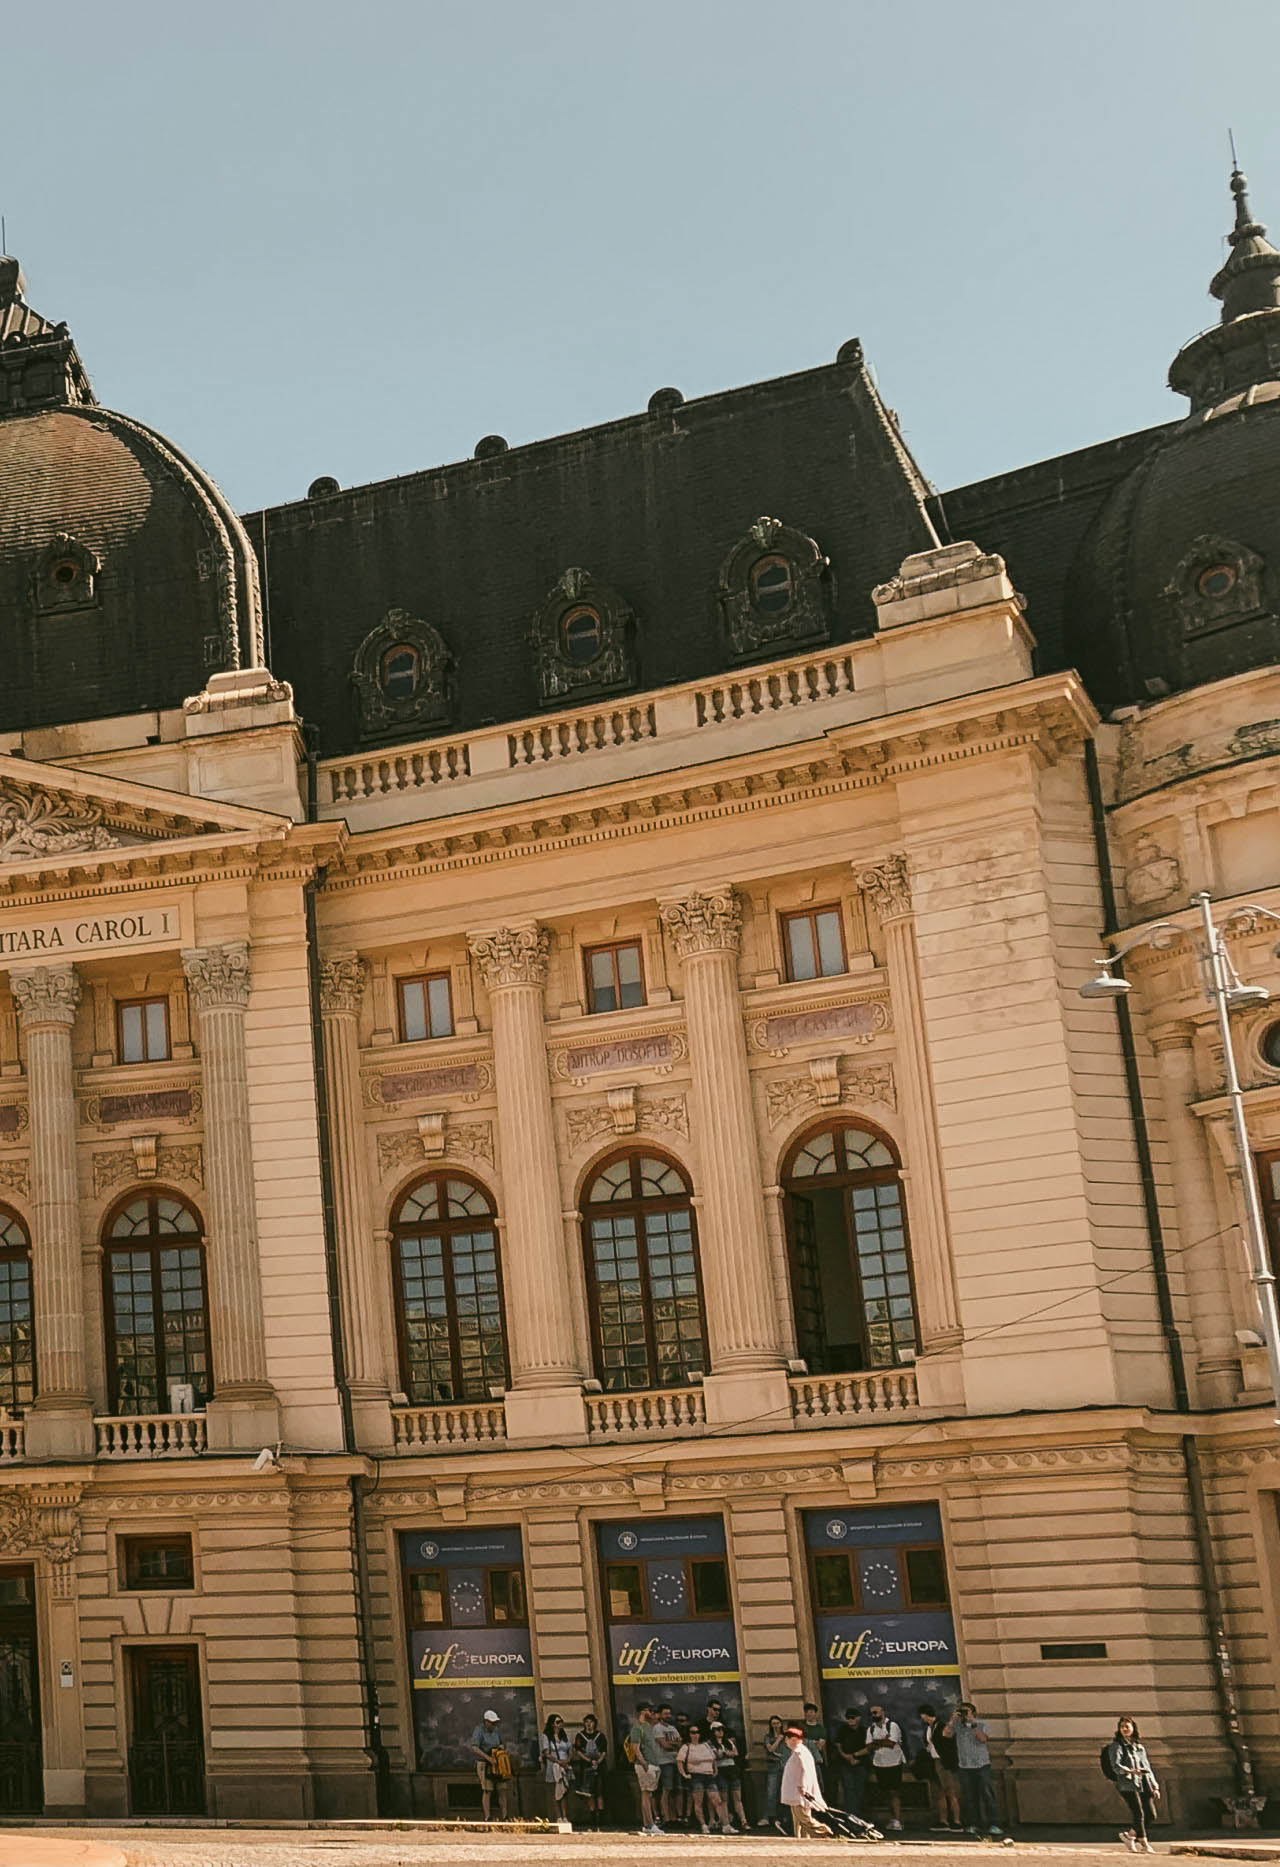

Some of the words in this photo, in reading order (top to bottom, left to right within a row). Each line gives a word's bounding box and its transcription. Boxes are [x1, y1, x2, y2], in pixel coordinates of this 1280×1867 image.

[75, 915, 152, 944] CAROL
[162, 912, 170, 934] I
[885, 1640, 949, 1653] EUROPA
[470, 1653, 525, 1665] EUROPA
[672, 1648, 730, 1660] EUROPA
[847, 1667, 935, 1677] www.infoeuropa.ro
[636, 1674, 717, 1683] www.infoeuropa.ro
